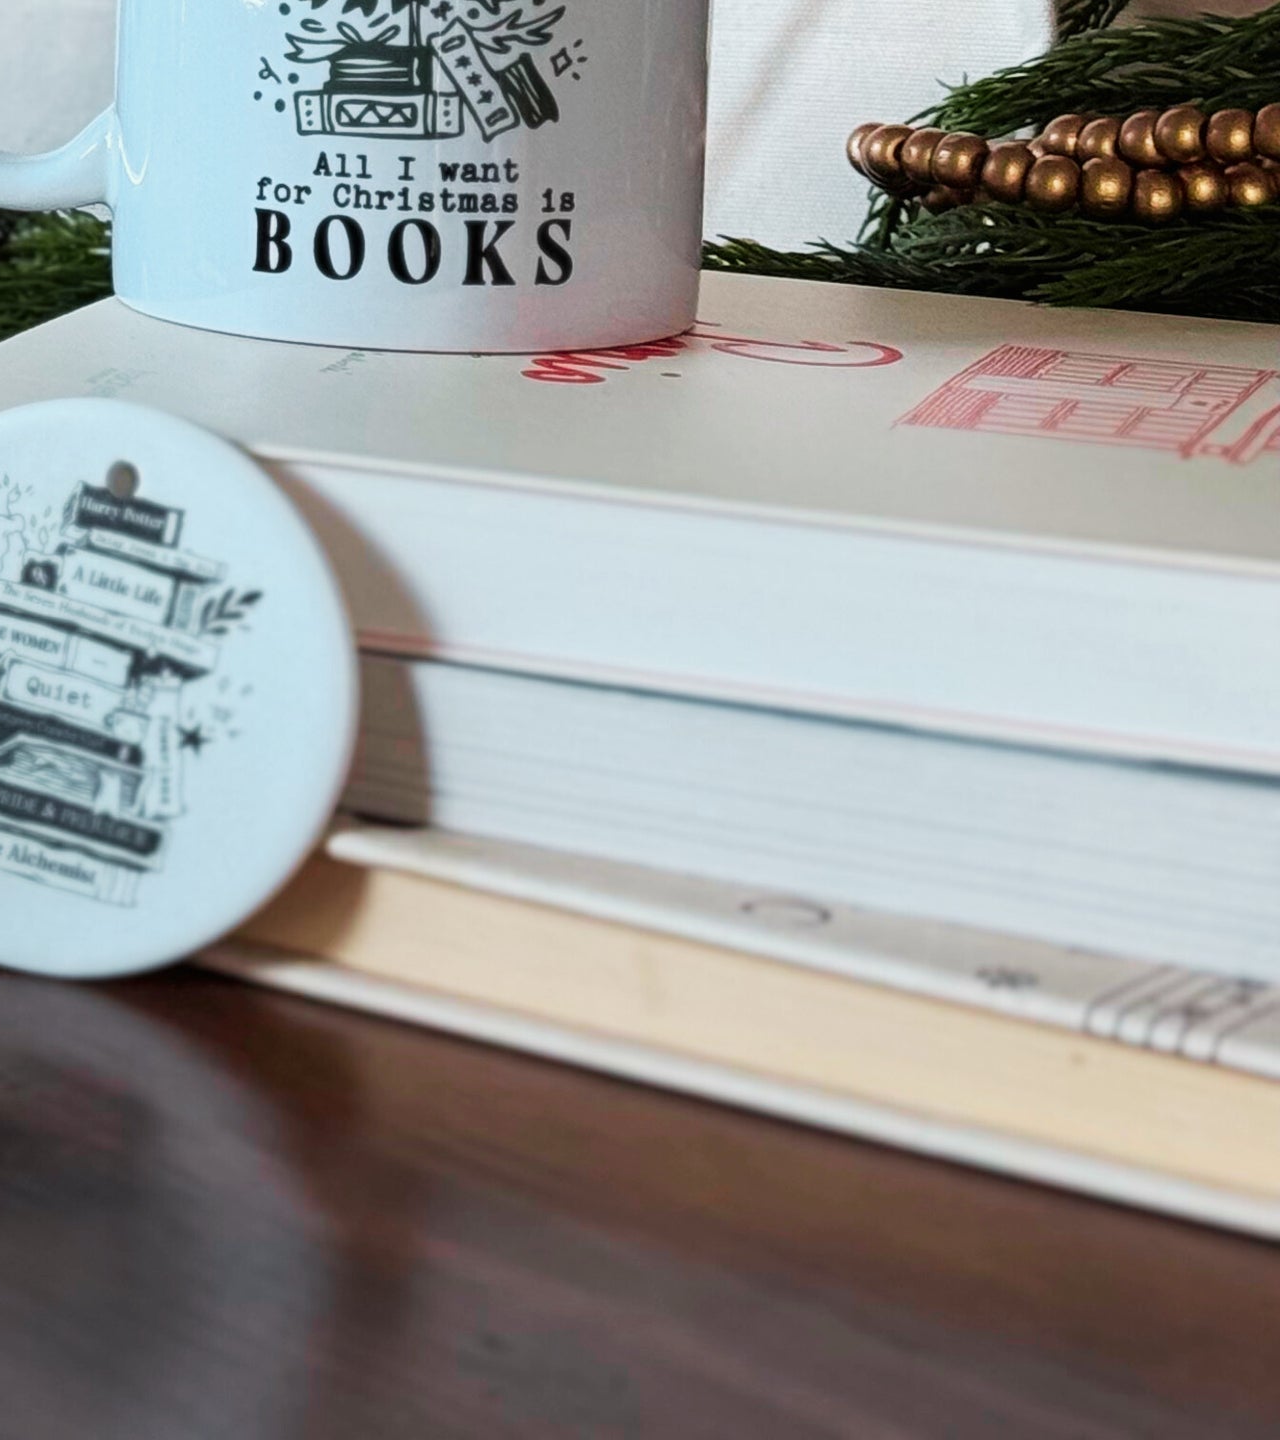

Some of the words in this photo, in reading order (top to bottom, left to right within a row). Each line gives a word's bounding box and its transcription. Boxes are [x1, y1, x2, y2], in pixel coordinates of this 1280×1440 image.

[313, 151, 373, 180] All
[397, 156, 416, 181] I
[438, 158, 520, 184] want
[256, 176, 312, 205] for
[333, 184, 519, 214] Christmas
[541, 188, 576, 213] is
[252, 207, 574, 287] BOOKS
[80, 495, 120, 520] Harry
[123, 504, 165, 530] Potter
[72, 565, 84, 582] A
[88, 569, 129, 597] Little
[134, 585, 163, 607] Life
[10, 627, 62, 656] WOMEN
[25, 677, 93, 710] Quiet
[7, 843, 97, 884] Alchemist
